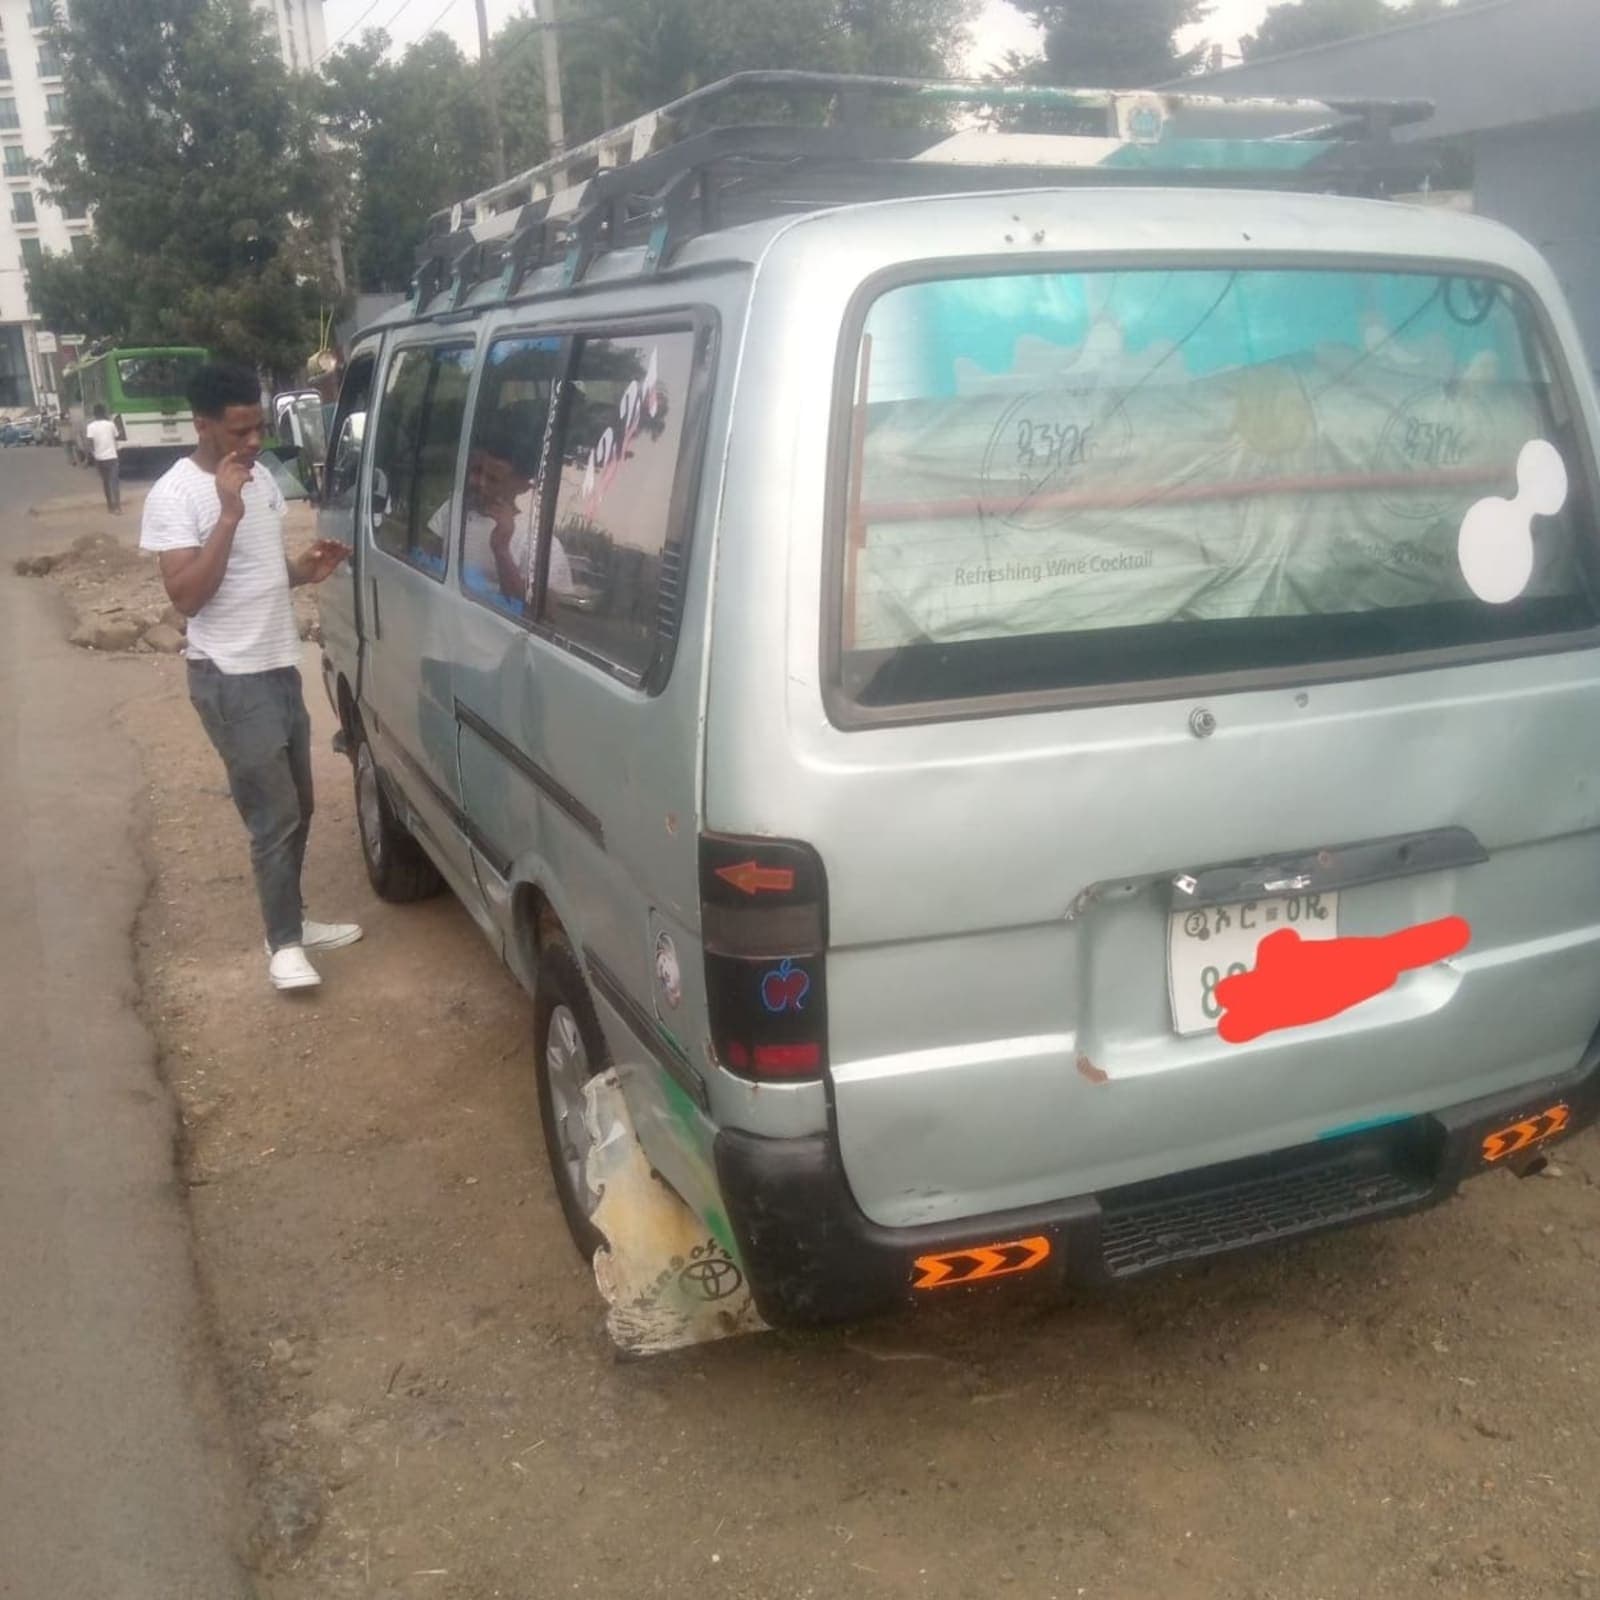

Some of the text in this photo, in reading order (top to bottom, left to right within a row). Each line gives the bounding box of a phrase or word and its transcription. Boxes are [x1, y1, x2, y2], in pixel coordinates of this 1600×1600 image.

[955, 550, 1153, 585] Refreshing Wine Cocktail
